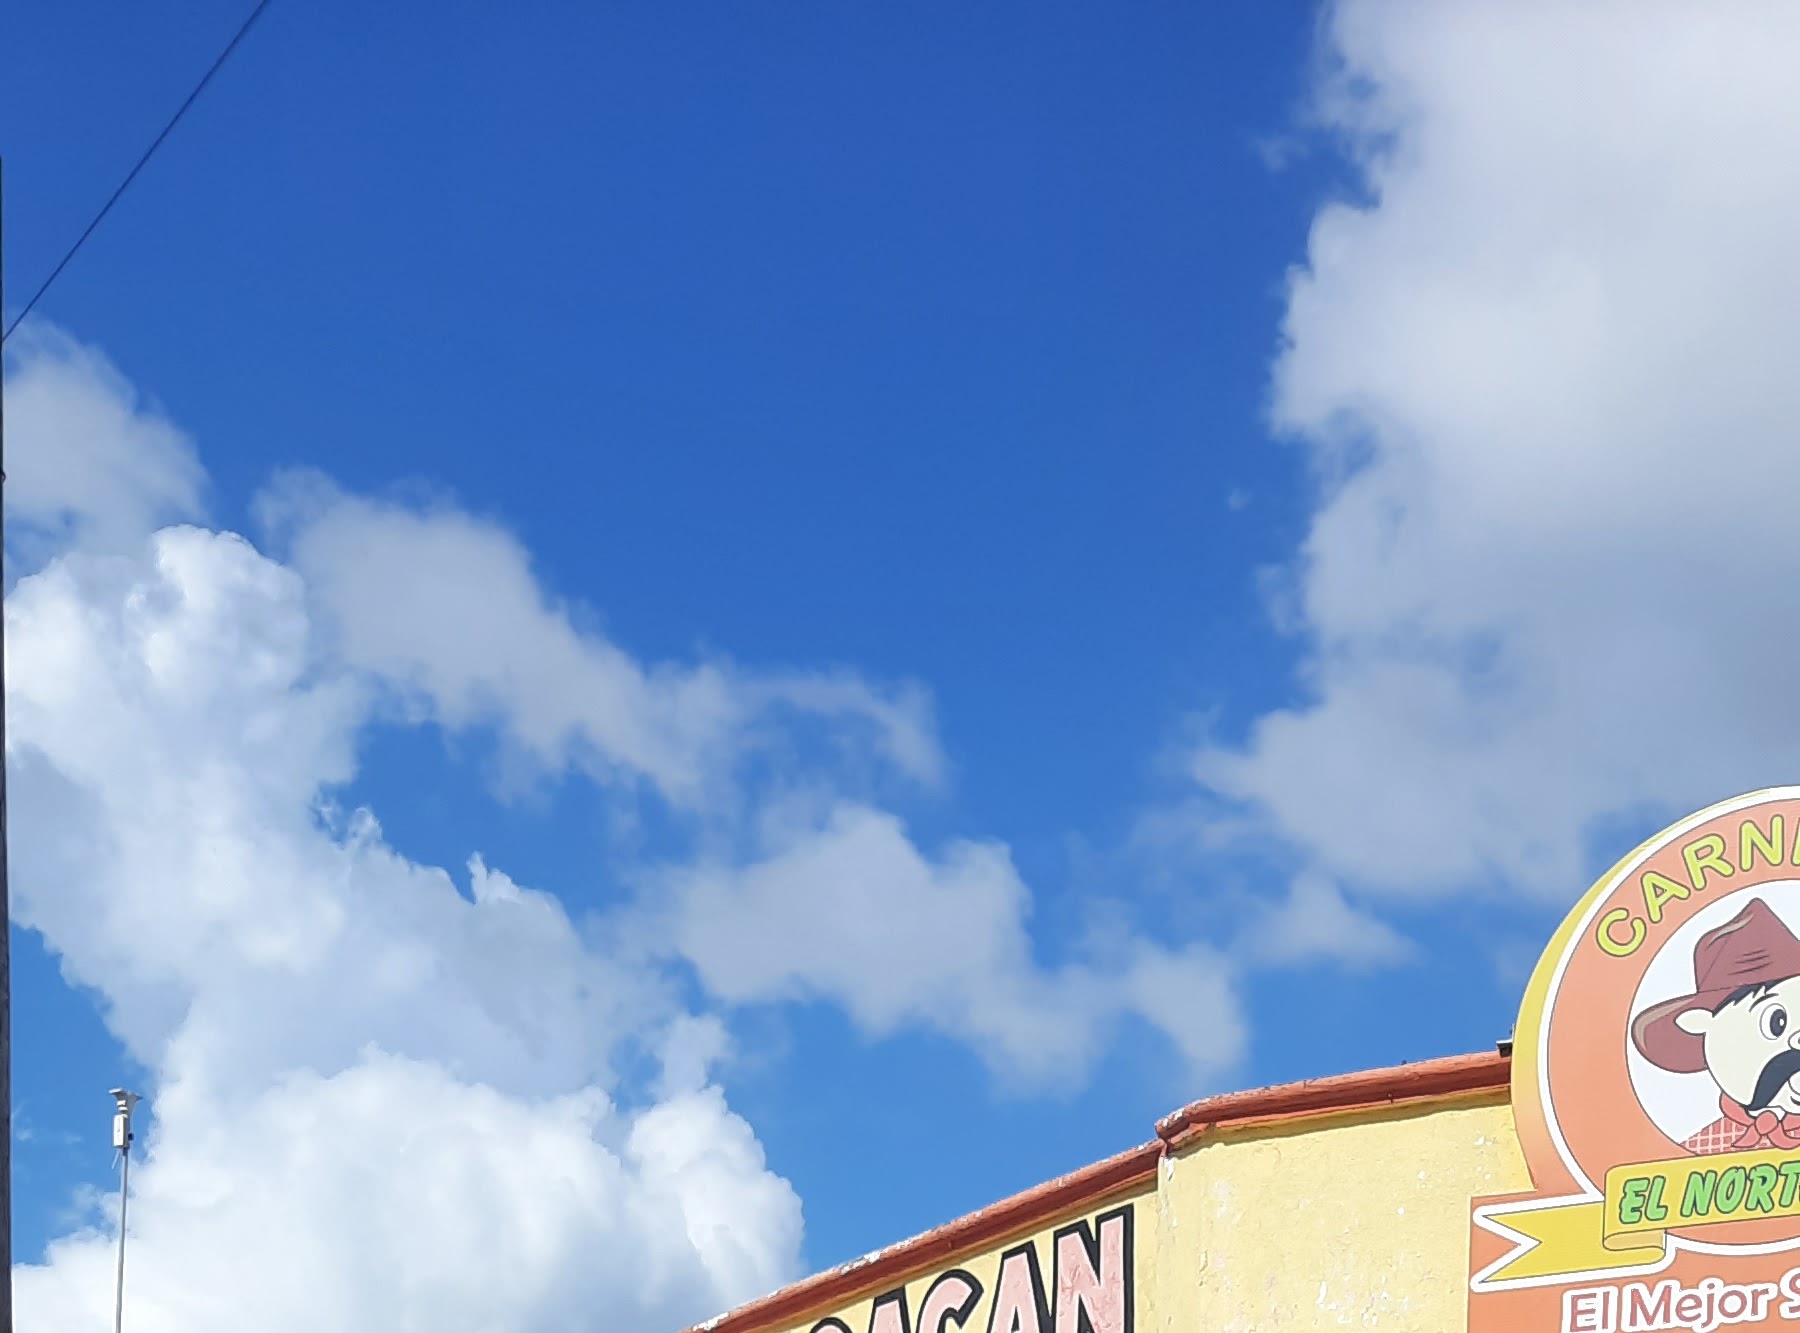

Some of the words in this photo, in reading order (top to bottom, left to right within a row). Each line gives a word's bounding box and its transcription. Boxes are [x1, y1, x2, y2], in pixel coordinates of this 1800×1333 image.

[1595, 813, 1800, 957] CARN
[1619, 1175, 1668, 1224] EL
[1680, 1160, 1800, 1217] NORT
[1569, 1290, 1610, 1333] El
[1628, 1282, 1770, 1328] Mejor
